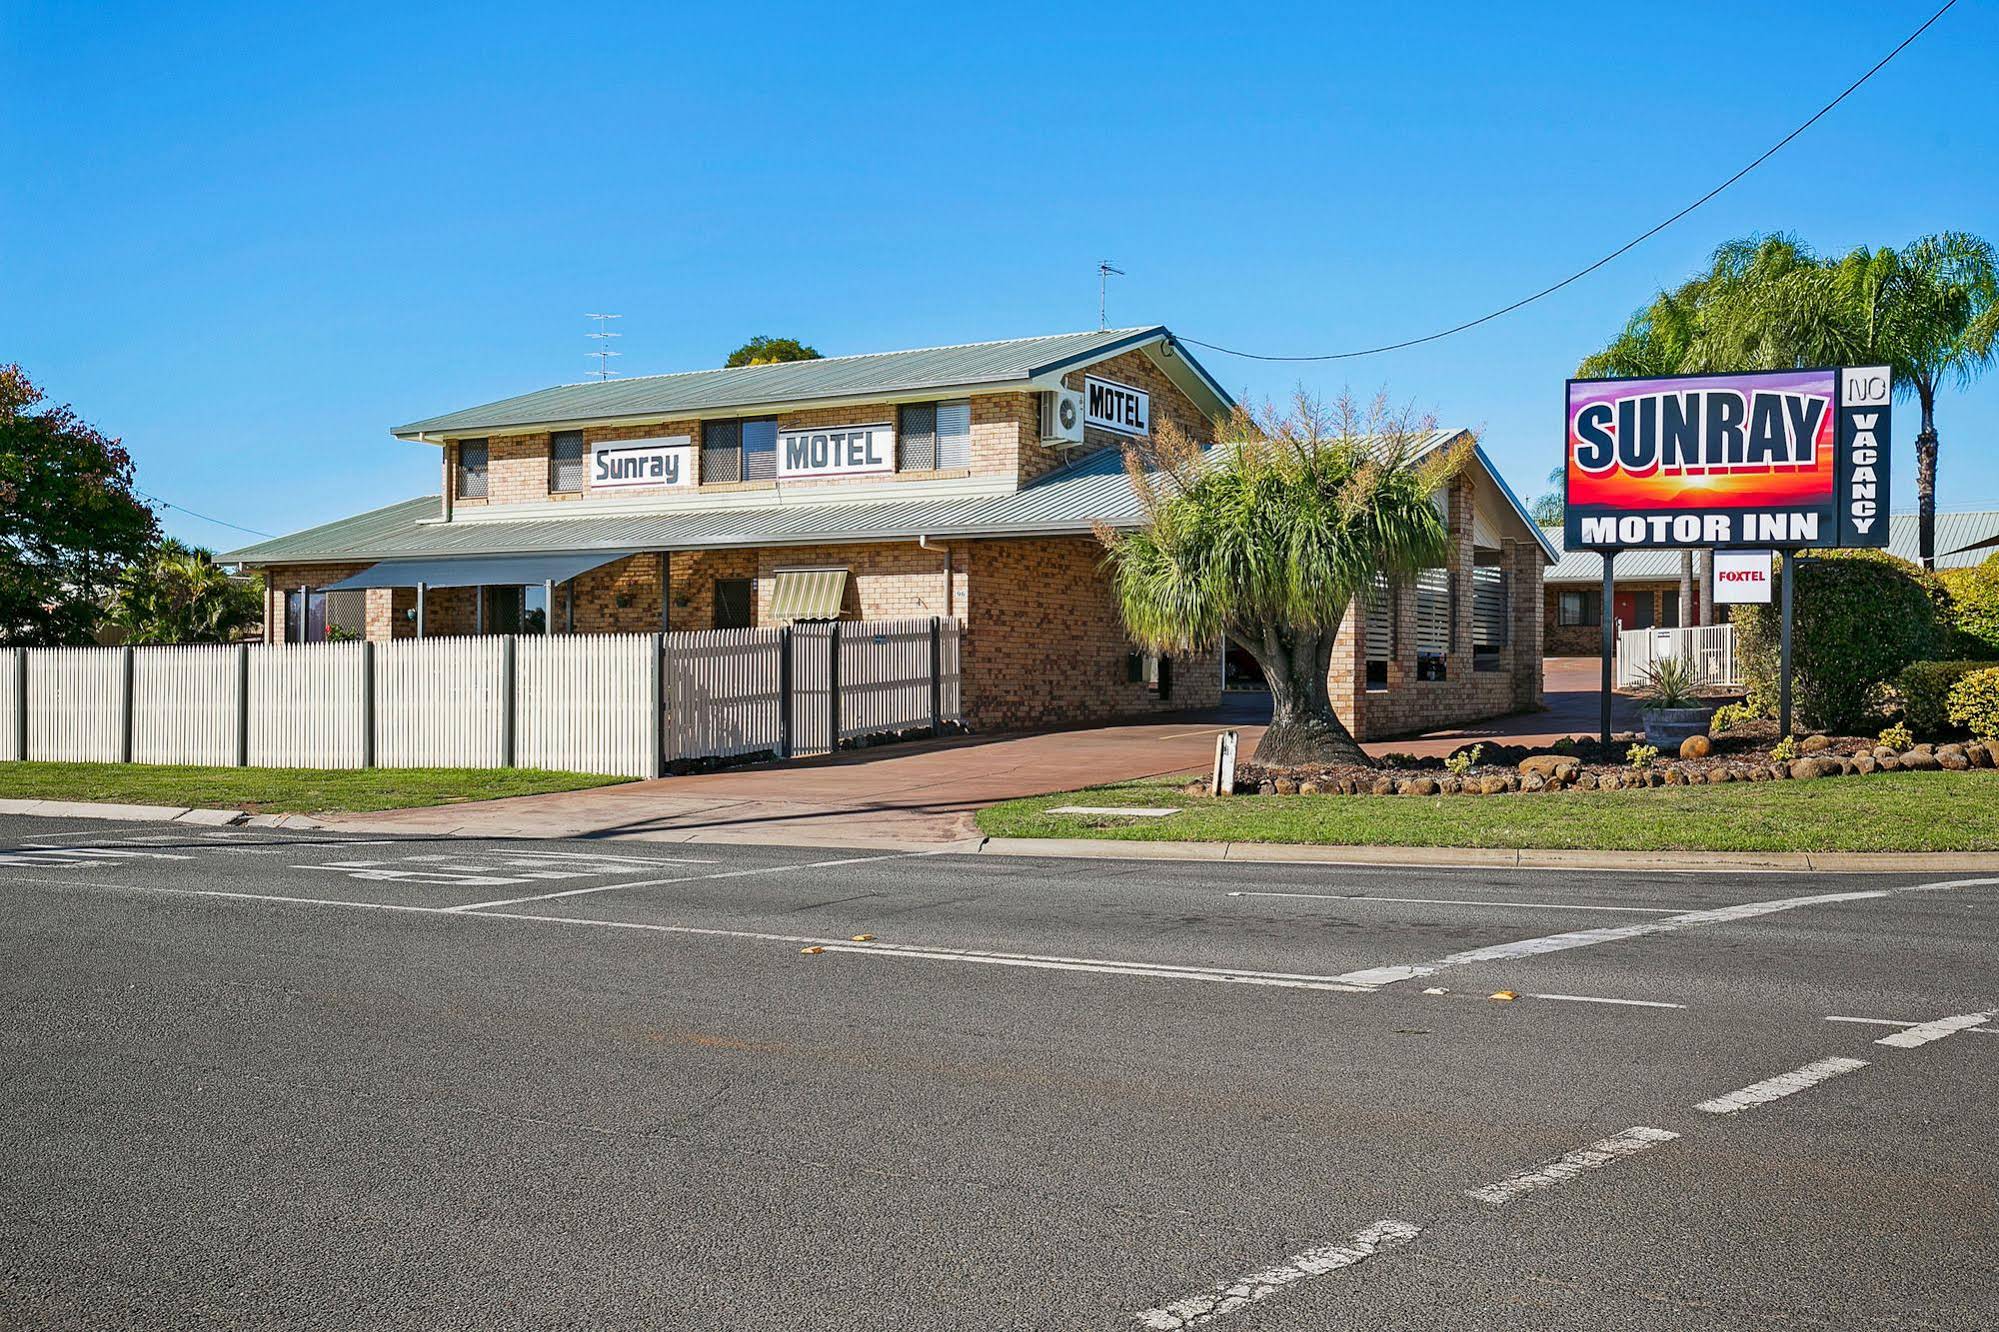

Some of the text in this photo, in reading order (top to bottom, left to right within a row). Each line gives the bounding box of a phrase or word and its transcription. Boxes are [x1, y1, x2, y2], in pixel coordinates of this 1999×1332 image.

[1089, 383, 1145, 429] MOTEL
[1848, 376, 1886, 402] NO
[1574, 389, 1831, 473] SUNRAY
[596, 450, 679, 484] Sunray
[786, 431, 882, 470] MOTEL
[1851, 413, 1879, 534] VACANCY
[1581, 512, 1819, 544] MOTOR INN
[1719, 570, 1766, 582] FOXTEL
